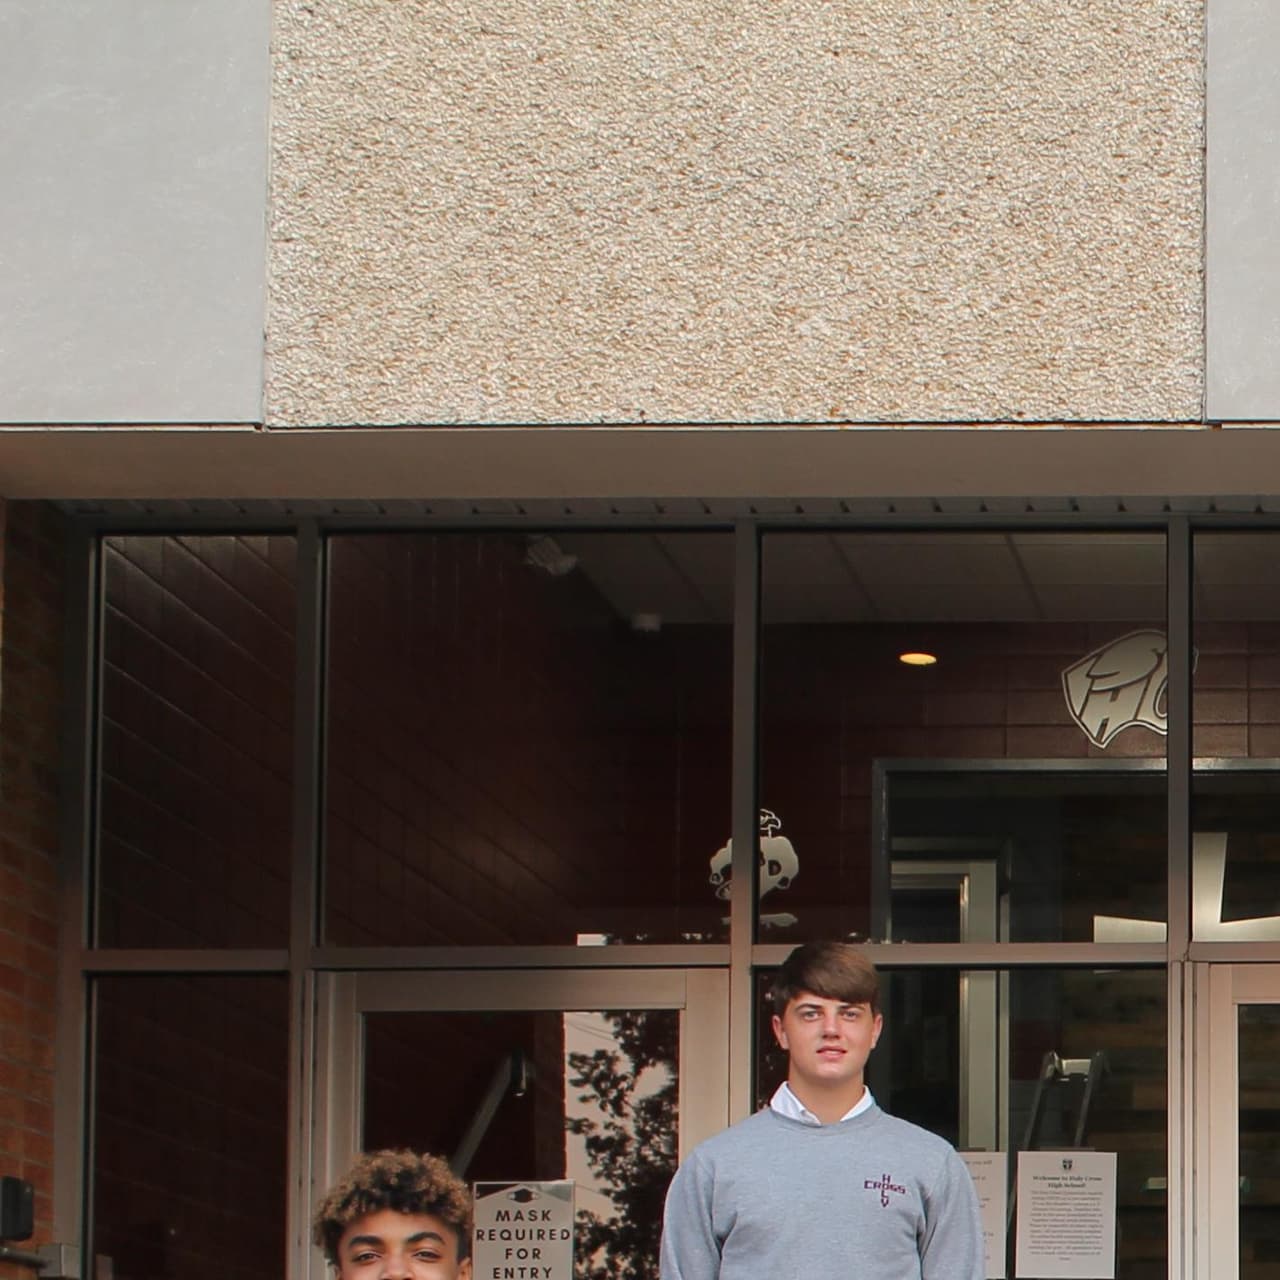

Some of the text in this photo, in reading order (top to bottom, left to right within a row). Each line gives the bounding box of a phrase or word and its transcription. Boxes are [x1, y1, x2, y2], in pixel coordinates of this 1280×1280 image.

[495, 1209, 552, 1222] MASK
[475, 1228, 571, 1241] REQUIRED
[504, 1247, 542, 1260] FOR
[492, 1266, 553, 1280] ENTRY
